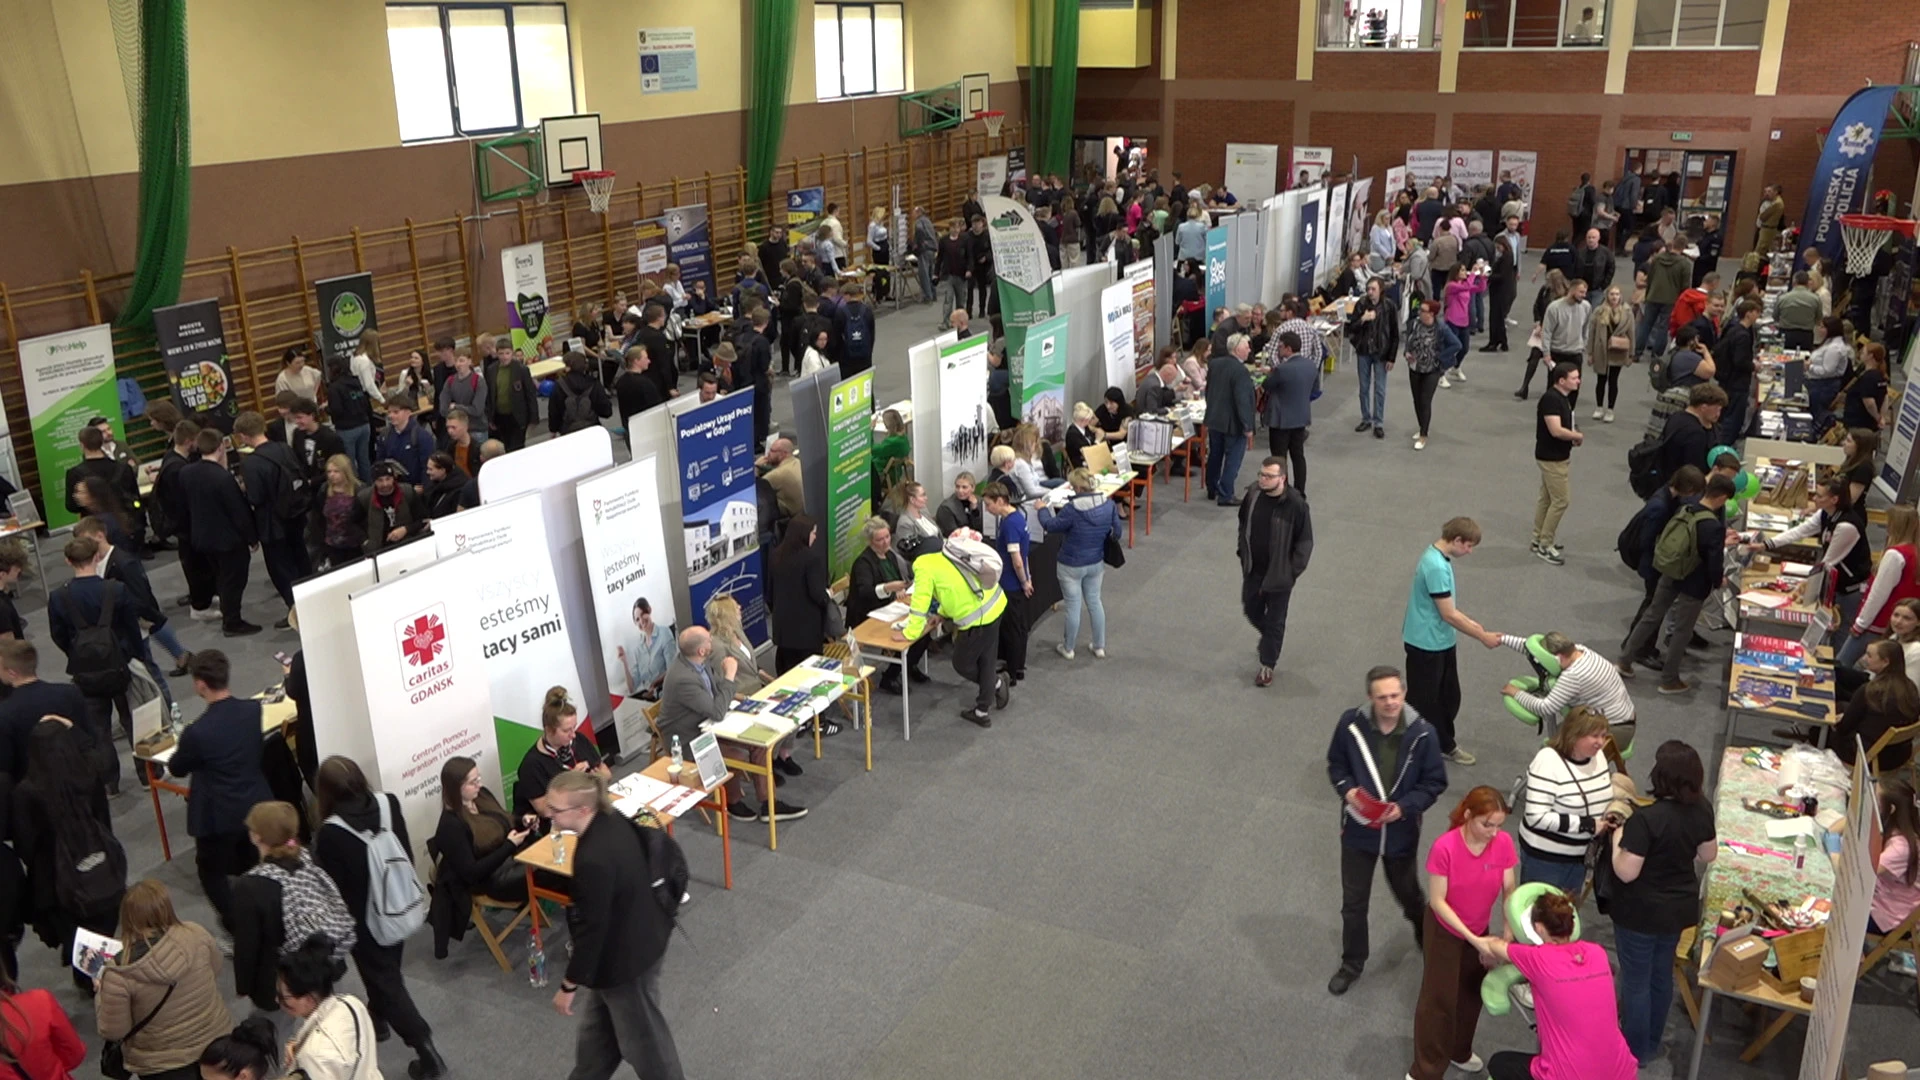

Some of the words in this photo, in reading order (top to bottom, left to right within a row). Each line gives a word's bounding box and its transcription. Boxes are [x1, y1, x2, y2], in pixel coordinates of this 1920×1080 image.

[1816, 166, 1846, 242] POMORSKA
[1834, 168, 1859, 221] POLICJA
[55, 340, 88, 354] ProHelp
[680, 419, 716, 439] Powiatowy
[716, 410, 735, 425] Urząd
[736, 405, 753, 418] Pracy
[706, 431, 713, 439] w
[713, 422, 732, 437] Gdyni
[603, 552, 641, 581] jesteśmy
[607, 577, 625, 595] tacy
[625, 563, 646, 585] sami
[480, 593, 549, 631] esteśmy
[483, 633, 517, 659] tacy
[521, 613, 562, 644] sami
[408, 661, 450, 687] caritas
[410, 676, 454, 705] GDAŃSK
[402, 754, 438, 780] Migrantom
[443, 732, 481, 758] Uchodźcom
[411, 741, 442, 763] Centrum
[442, 728, 469, 747] Pomocy
[404, 773, 439, 798] Migration
